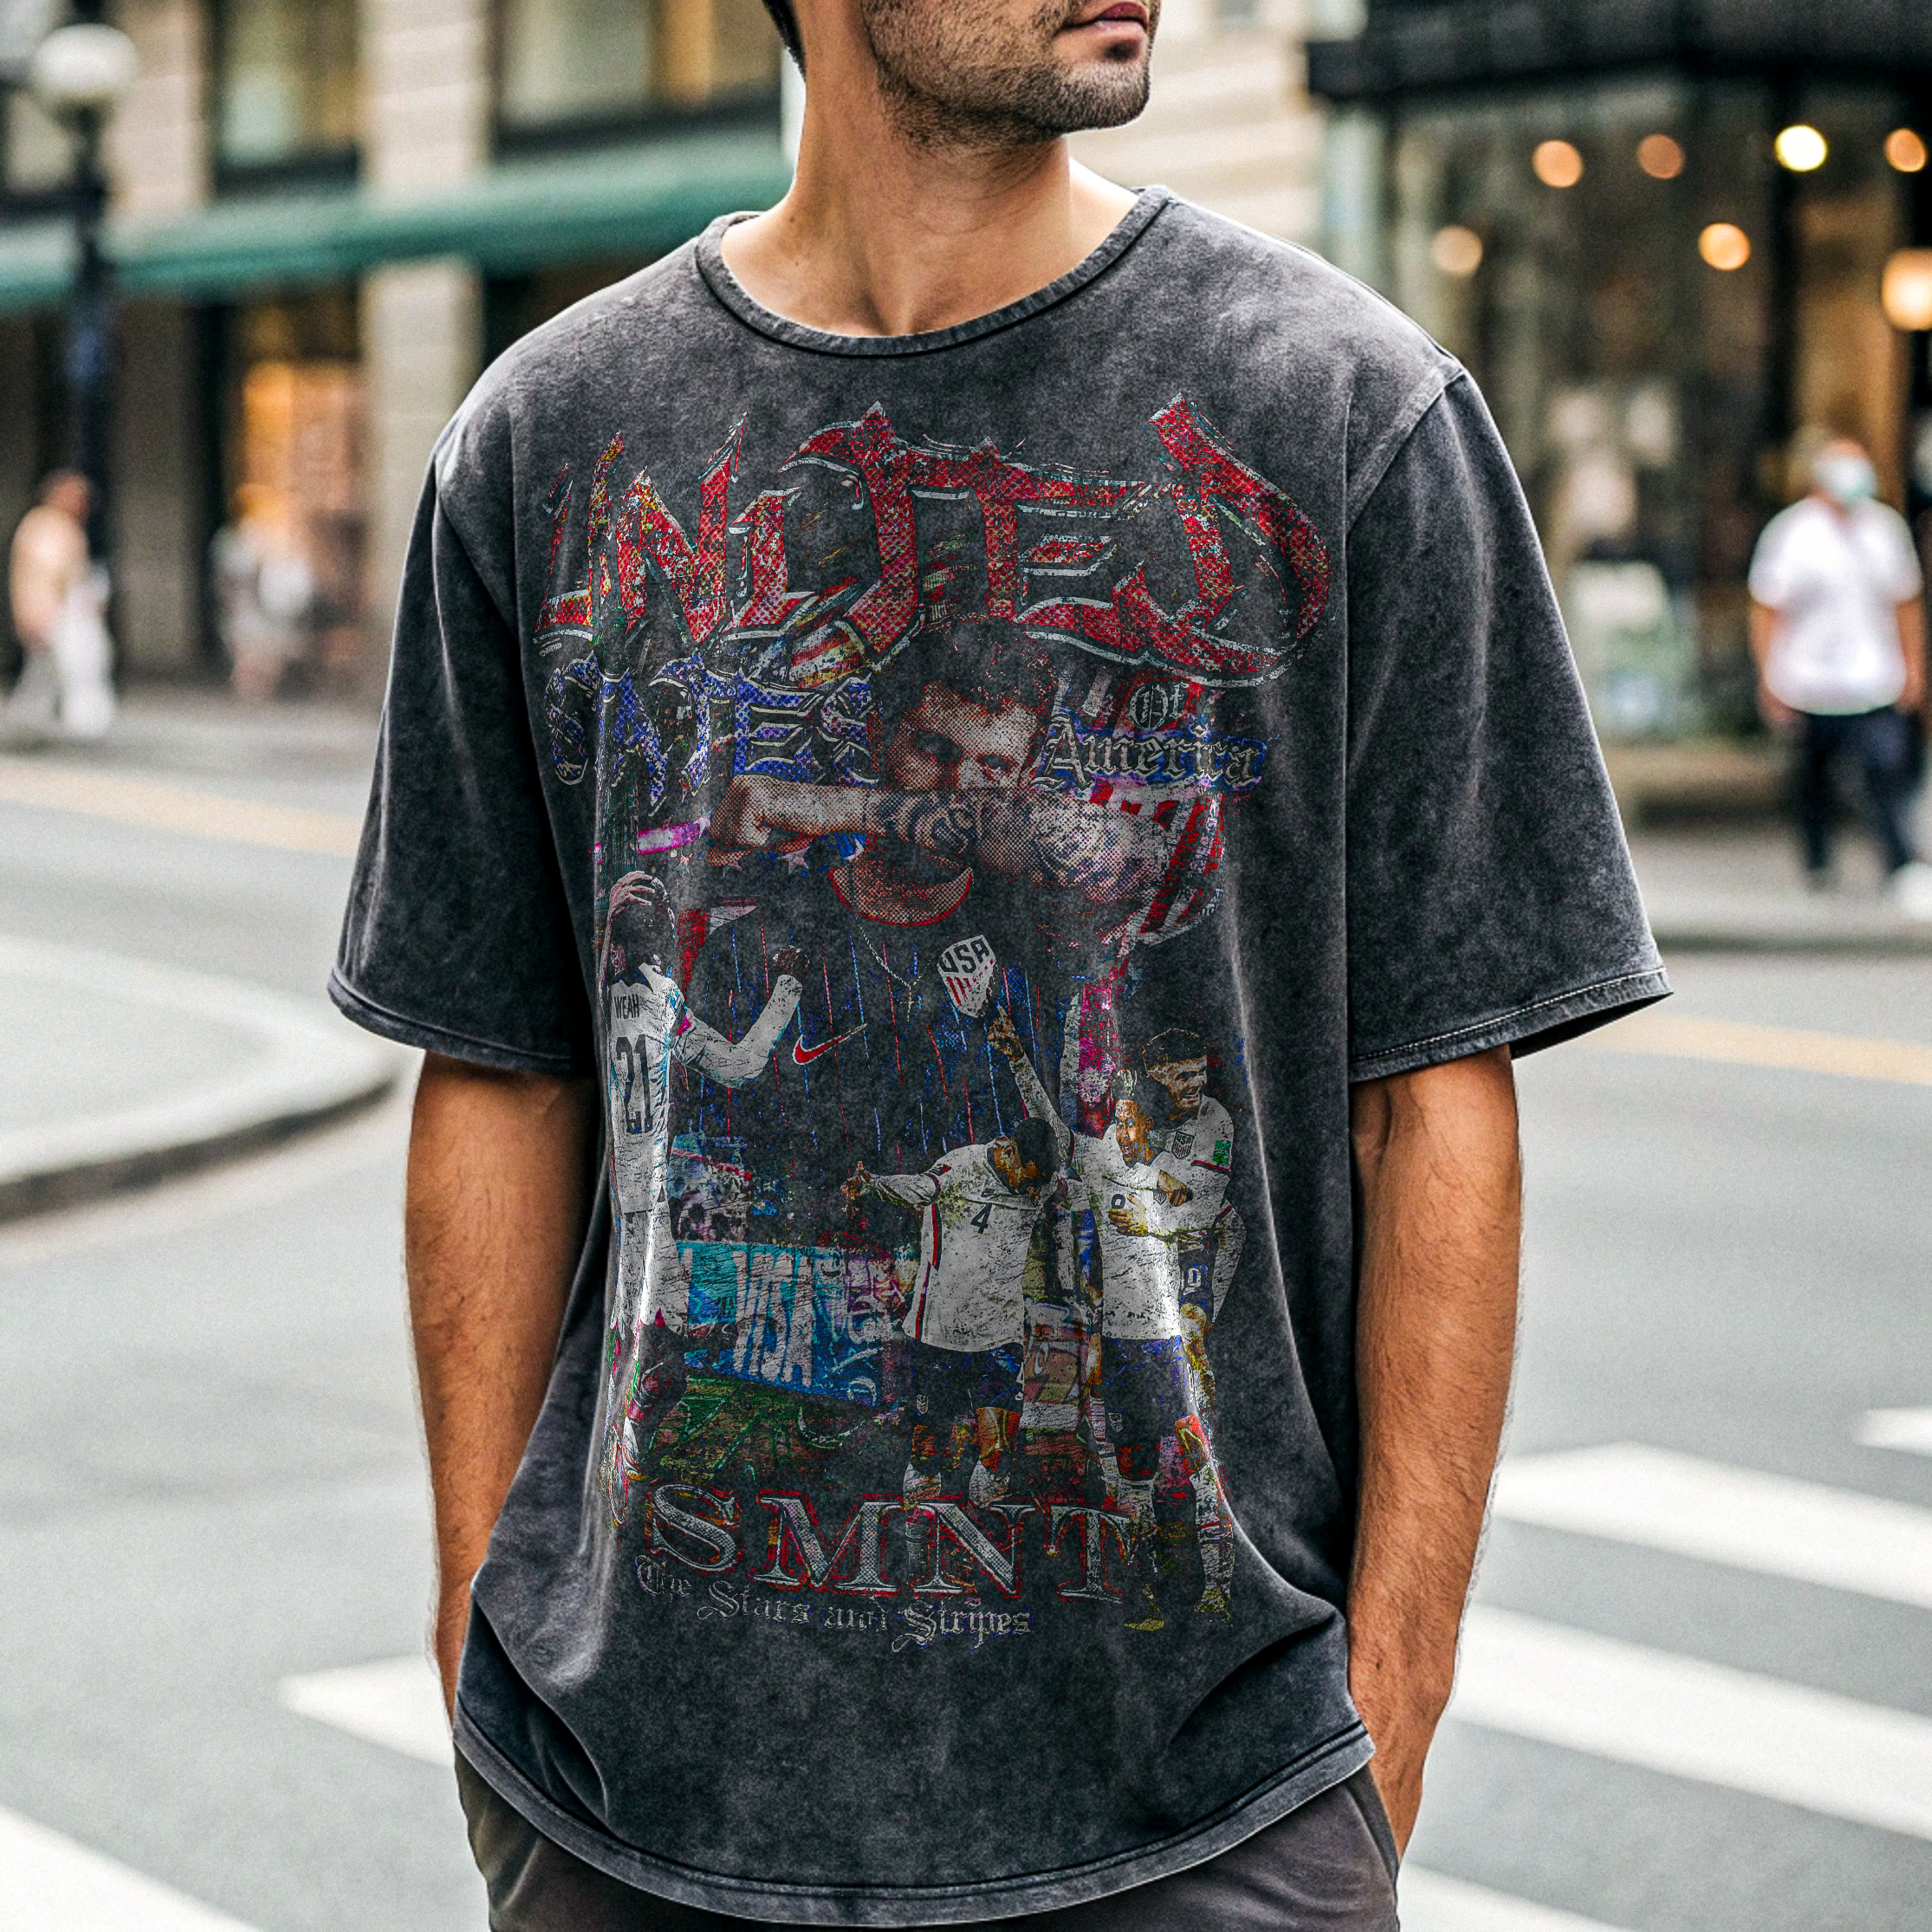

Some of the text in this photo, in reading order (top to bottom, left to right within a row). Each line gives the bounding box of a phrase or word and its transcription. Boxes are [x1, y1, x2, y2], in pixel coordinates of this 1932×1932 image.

[535, 392, 1335, 688] UNITED
[1127, 682, 1190, 730] Of
[1031, 715, 1262, 790] America
[939, 938, 990, 974] USA
[613, 994, 639, 1019] WEAH
[616, 1034, 653, 1134] 21
[970, 1203, 992, 1235] 4
[646, 1480, 1129, 1605] SMNT
[697, 1580, 812, 1625] Stars
[891, 1598, 1034, 1652] Stripes
